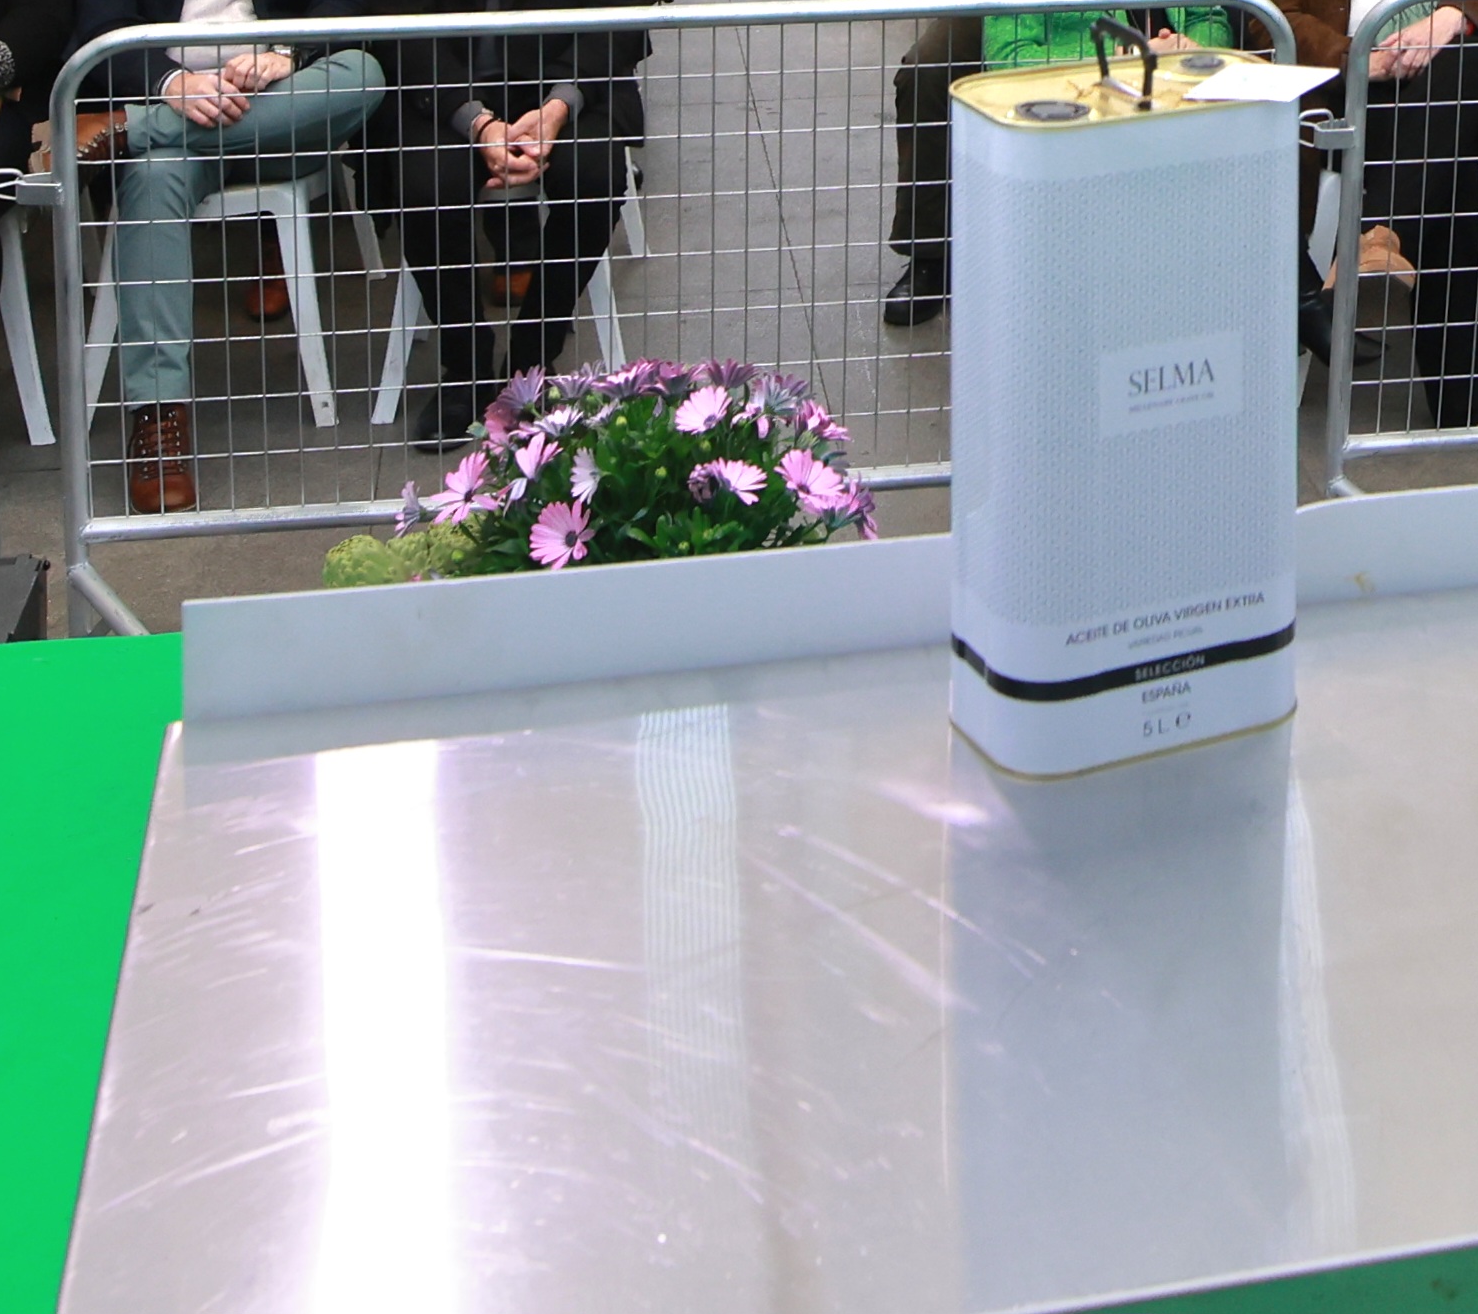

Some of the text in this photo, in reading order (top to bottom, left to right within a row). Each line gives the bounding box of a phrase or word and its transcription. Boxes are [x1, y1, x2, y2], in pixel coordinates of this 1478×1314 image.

[1127, 357, 1215, 398] SELMA
[1065, 591, 1266, 646] ACEITE DE OLIVA VIRGEN EXTRA
[1134, 653, 1206, 681] SELECCIÓN
[1141, 681, 1192, 704] ESPAÑA
[1143, 722, 1153, 738] 5
